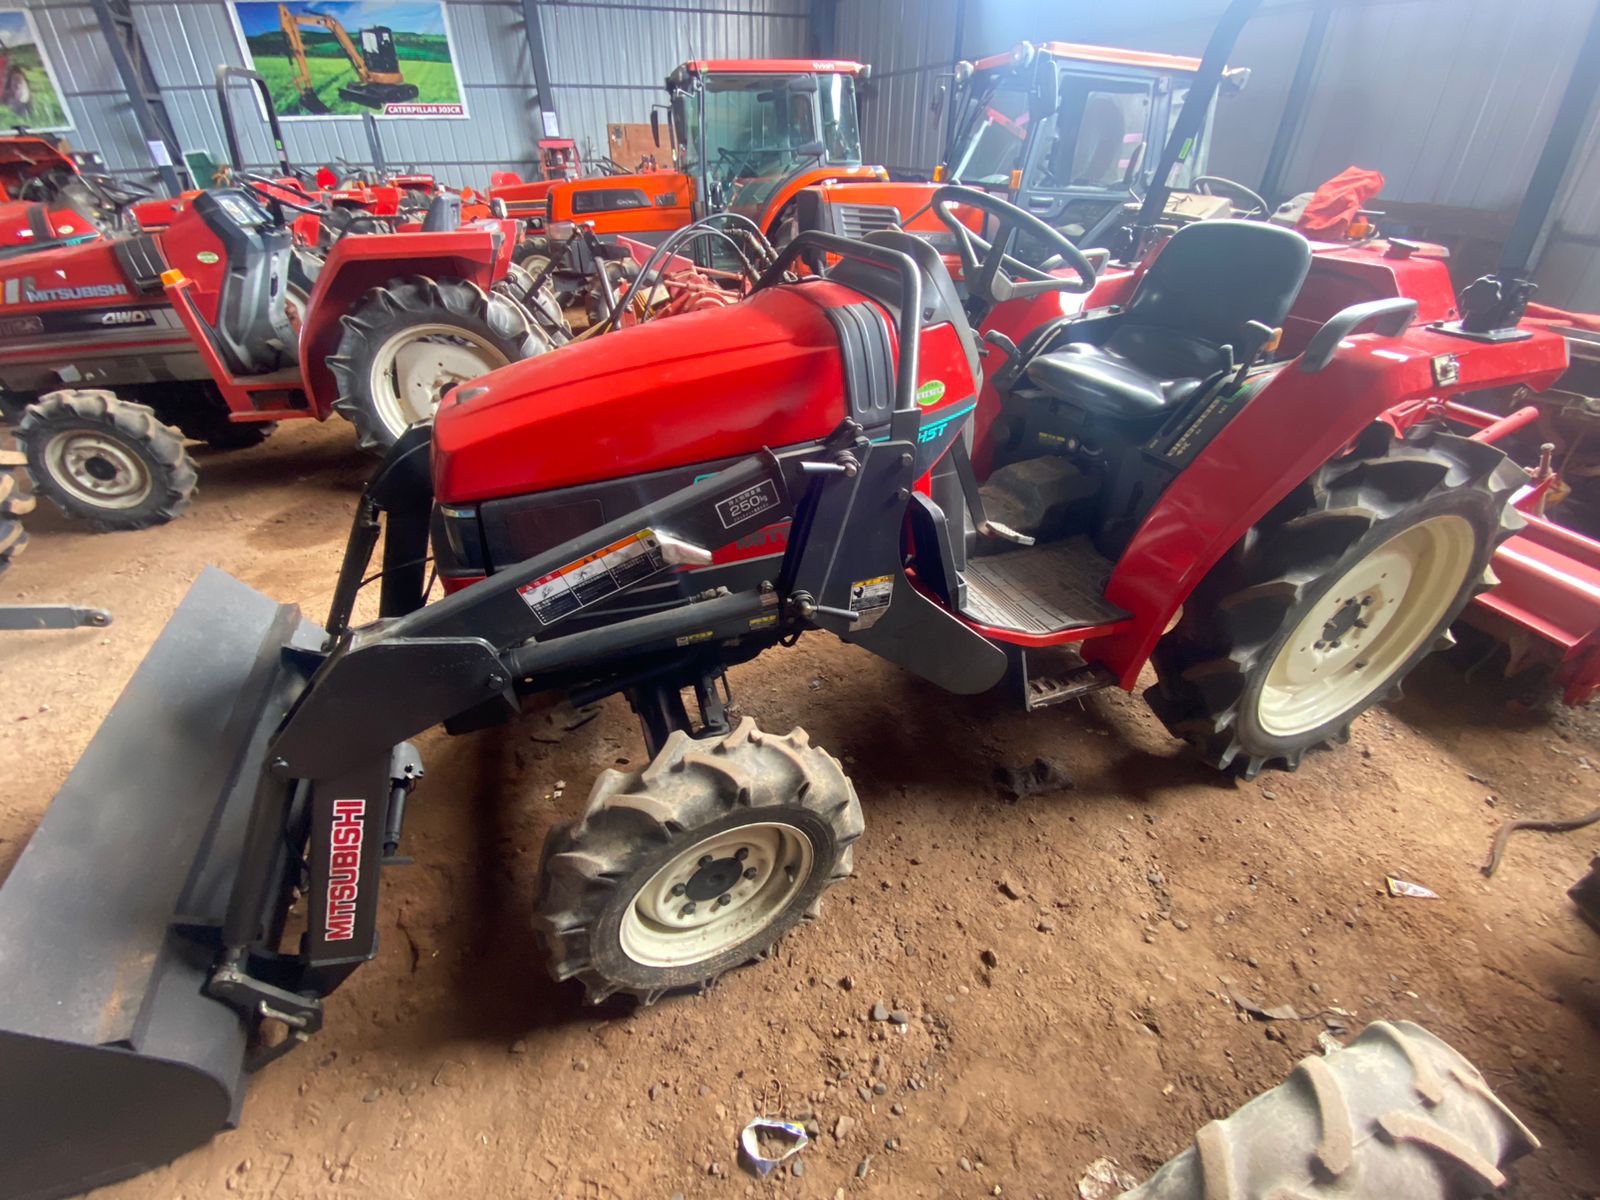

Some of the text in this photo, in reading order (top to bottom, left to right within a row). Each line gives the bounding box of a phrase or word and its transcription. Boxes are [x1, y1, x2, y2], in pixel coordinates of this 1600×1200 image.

[26, 283, 128, 303] MITSUBISHI
[918, 422, 948, 443] HST
[325, 800, 366, 941] MITSUBISHI
